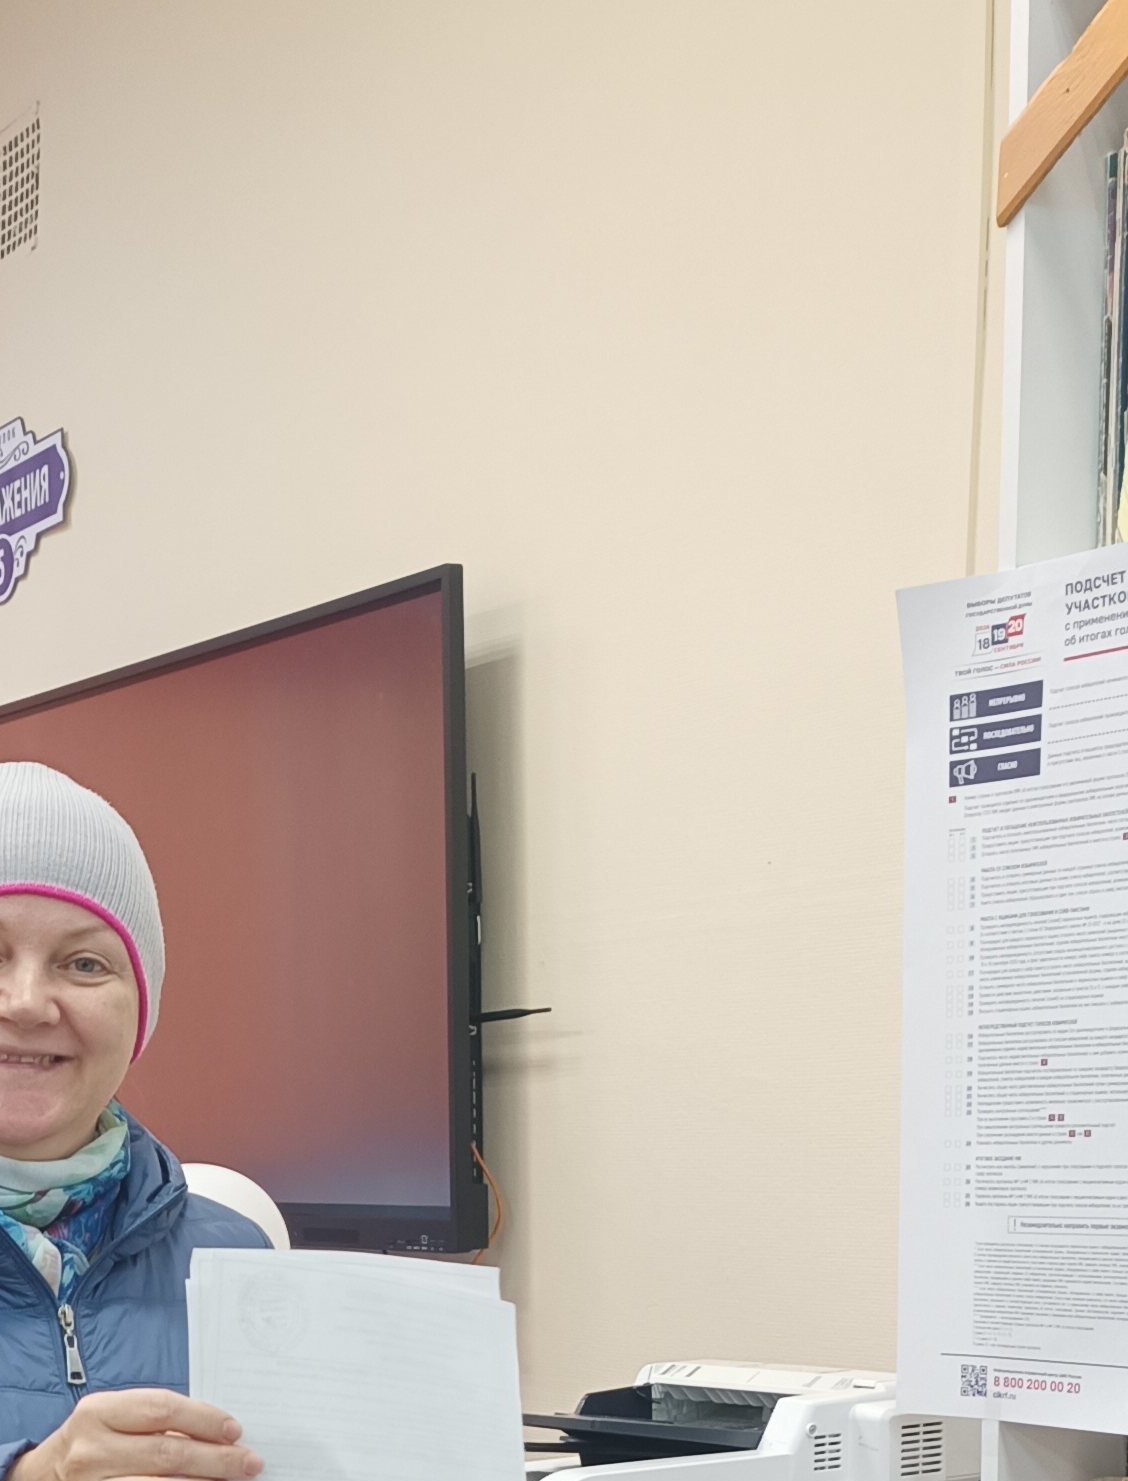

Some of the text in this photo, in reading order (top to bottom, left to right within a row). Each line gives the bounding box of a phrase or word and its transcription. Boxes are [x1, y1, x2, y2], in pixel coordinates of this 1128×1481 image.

[1065, 570, 1127, 596] ПОДСЧЕТ
[1065, 590, 1128, 615] УЧАСТКО
[977, 618, 1023, 650] 18 19 20
[1064, 622, 1071, 631] с
[1064, 634, 1077, 647] об
[1078, 629, 1113, 644] итогах
[993, 1376, 1081, 1394] 8 800 200 00 20
